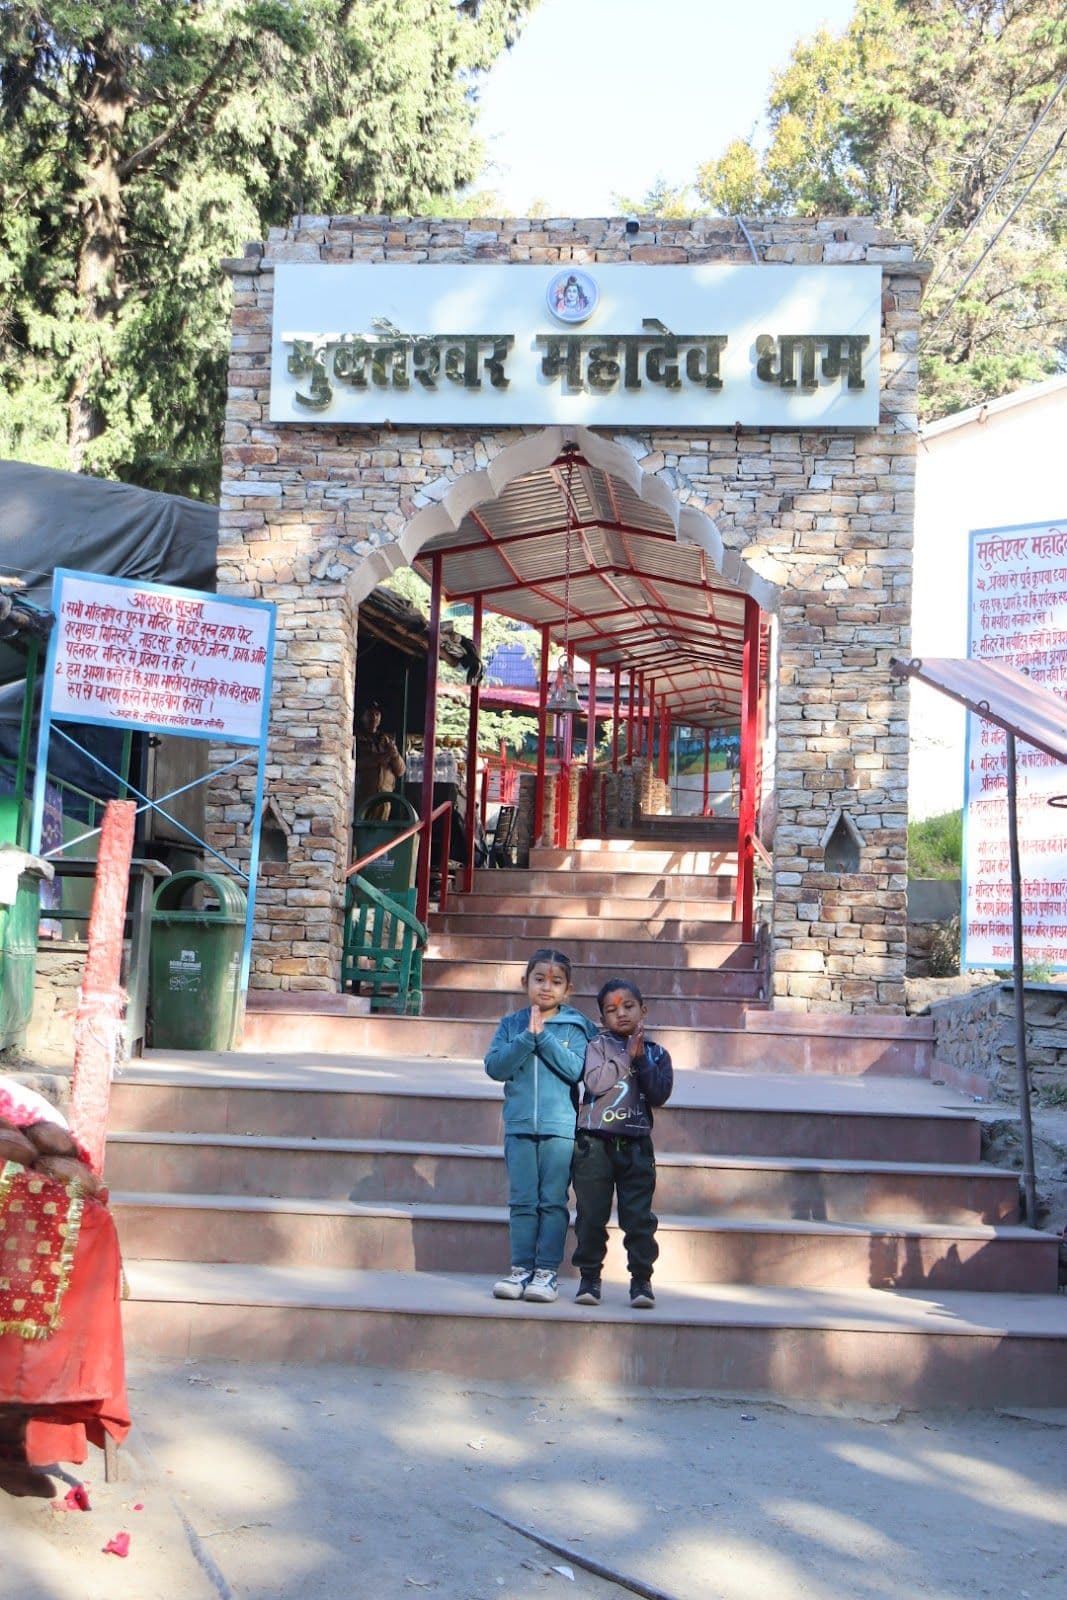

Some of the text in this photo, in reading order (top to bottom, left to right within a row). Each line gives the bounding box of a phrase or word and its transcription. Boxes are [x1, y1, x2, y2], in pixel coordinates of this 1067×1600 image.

[281, 316, 870, 408] मुक्तेश्वर महादेव धाम
[976, 535, 1029, 571] मुक्तेश्वर
[67, 600, 84, 619] सभी
[147, 612, 173, 634] मन्दिर
[200, 622, 220, 639] वस्त्र
[127, 593, 204, 619] आवश्यक सूचना
[66, 641, 99, 662] पहनकर
[102, 645, 128, 665] मन्दिर
[137, 649, 161, 669] प्रवेश
[162, 655, 171, 670] न
[67, 662, 82, 681] हम
[83, 665, 106, 681] आशा
[144, 672, 160, 688] आप
[95, 686, 121, 705] धारण
